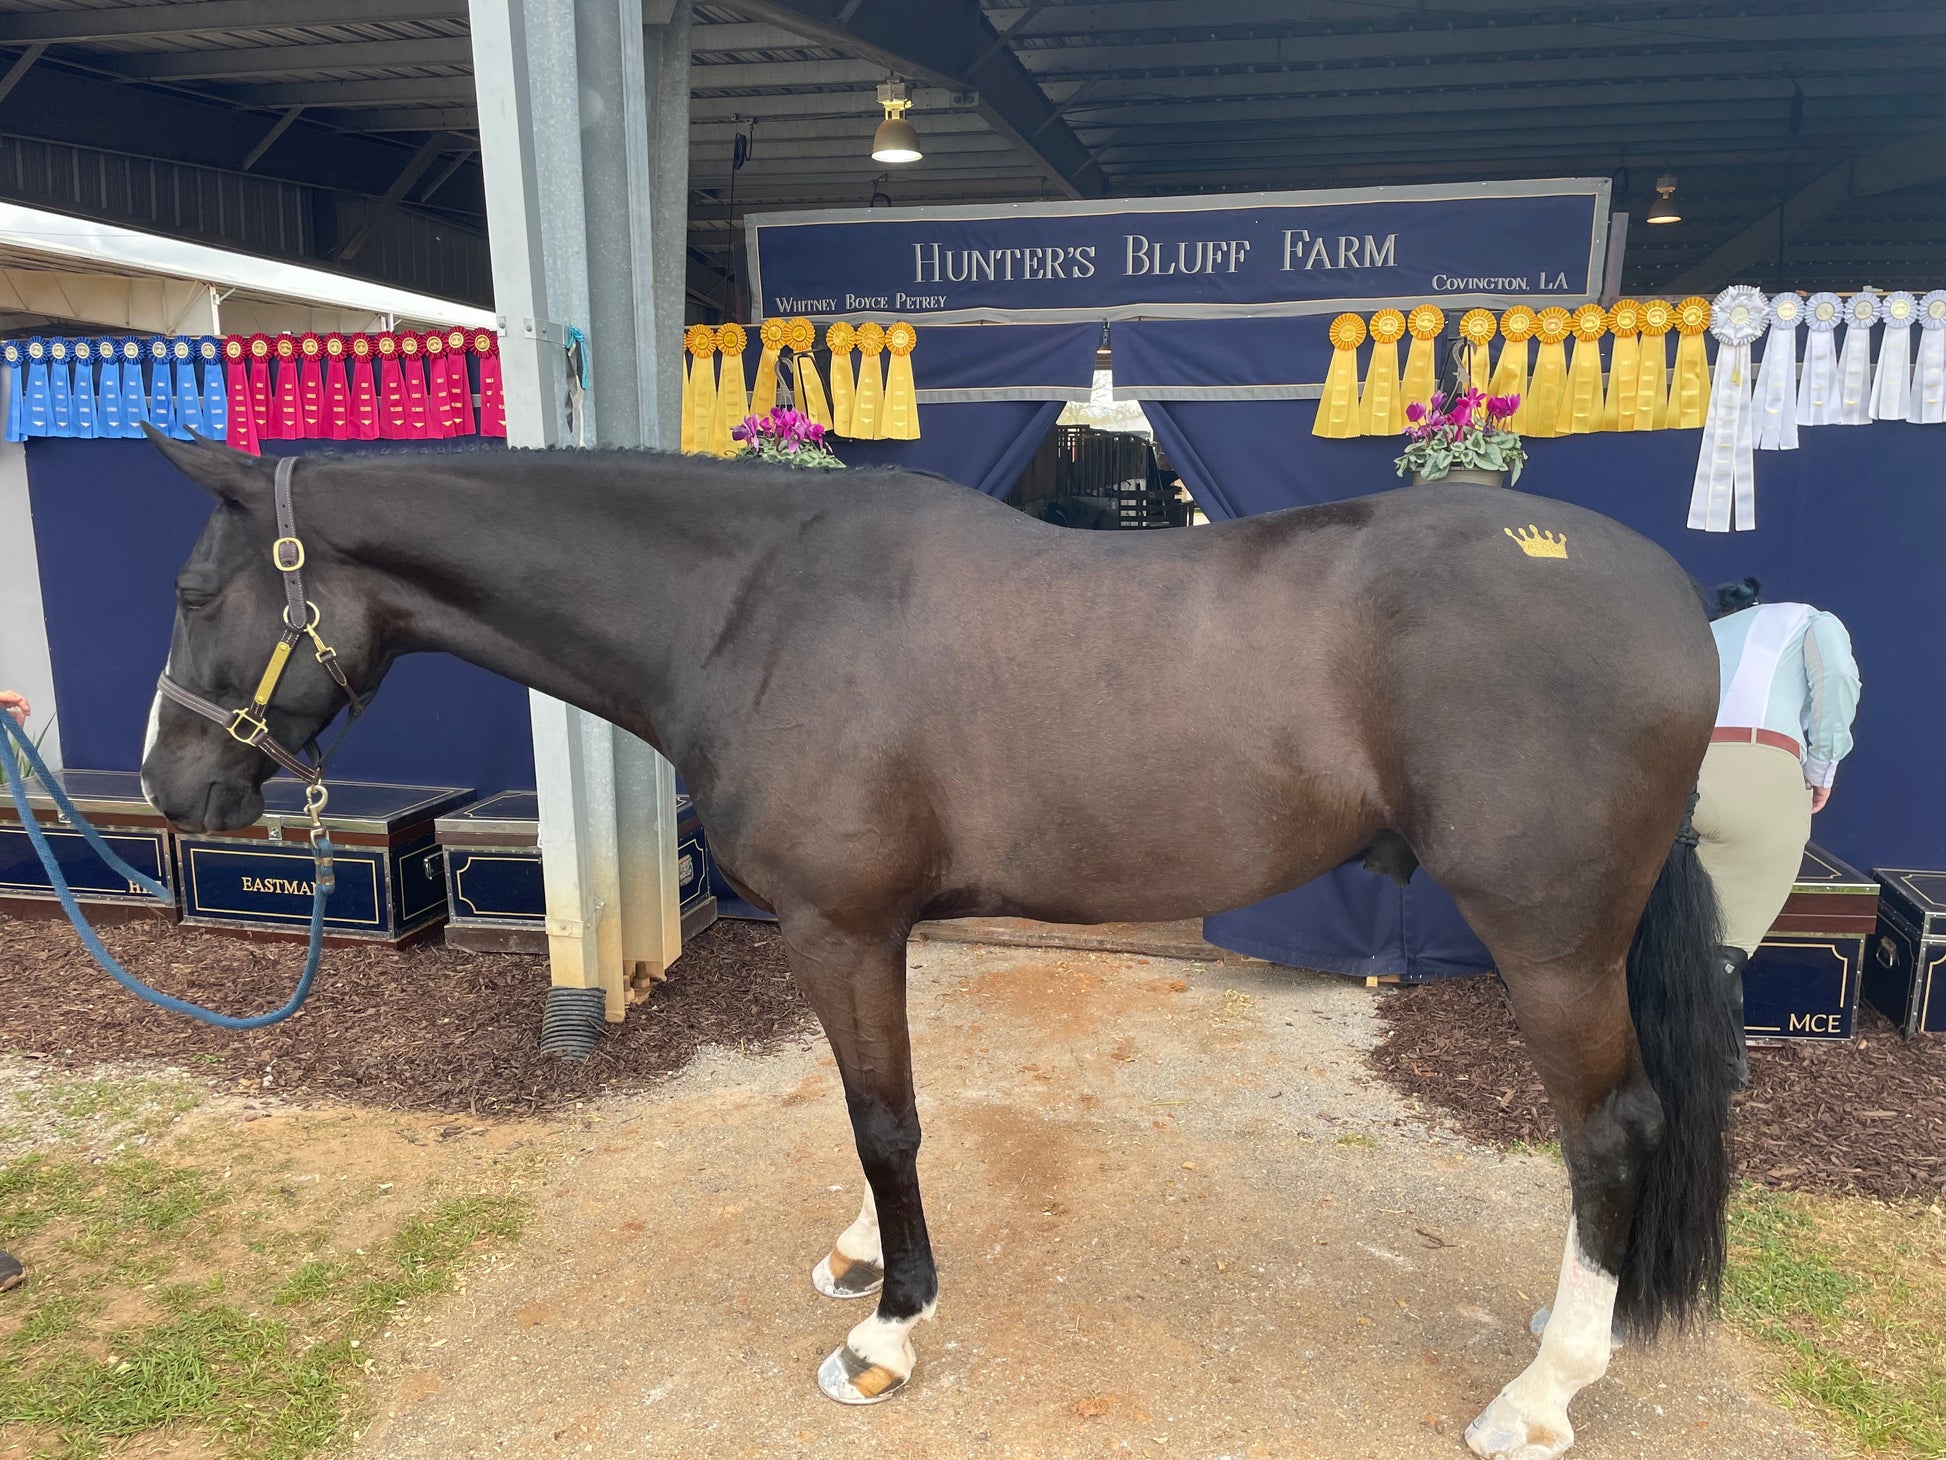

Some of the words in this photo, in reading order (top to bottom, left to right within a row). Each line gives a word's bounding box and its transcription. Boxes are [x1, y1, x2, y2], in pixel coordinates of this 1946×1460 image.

[912, 242, 1096, 283] HUNTER'S
[1122, 234, 1251, 276] BLUFF
[1279, 229, 1399, 271] FARM
[1431, 274, 1530, 291] COVINGTON,
[1539, 271, 1569, 290] LA
[775, 296, 837, 313] WHITNEY
[845, 293, 888, 310] BOYCE
[895, 292, 947, 309] PETREY
[1789, 1013, 1841, 1033] MCE
